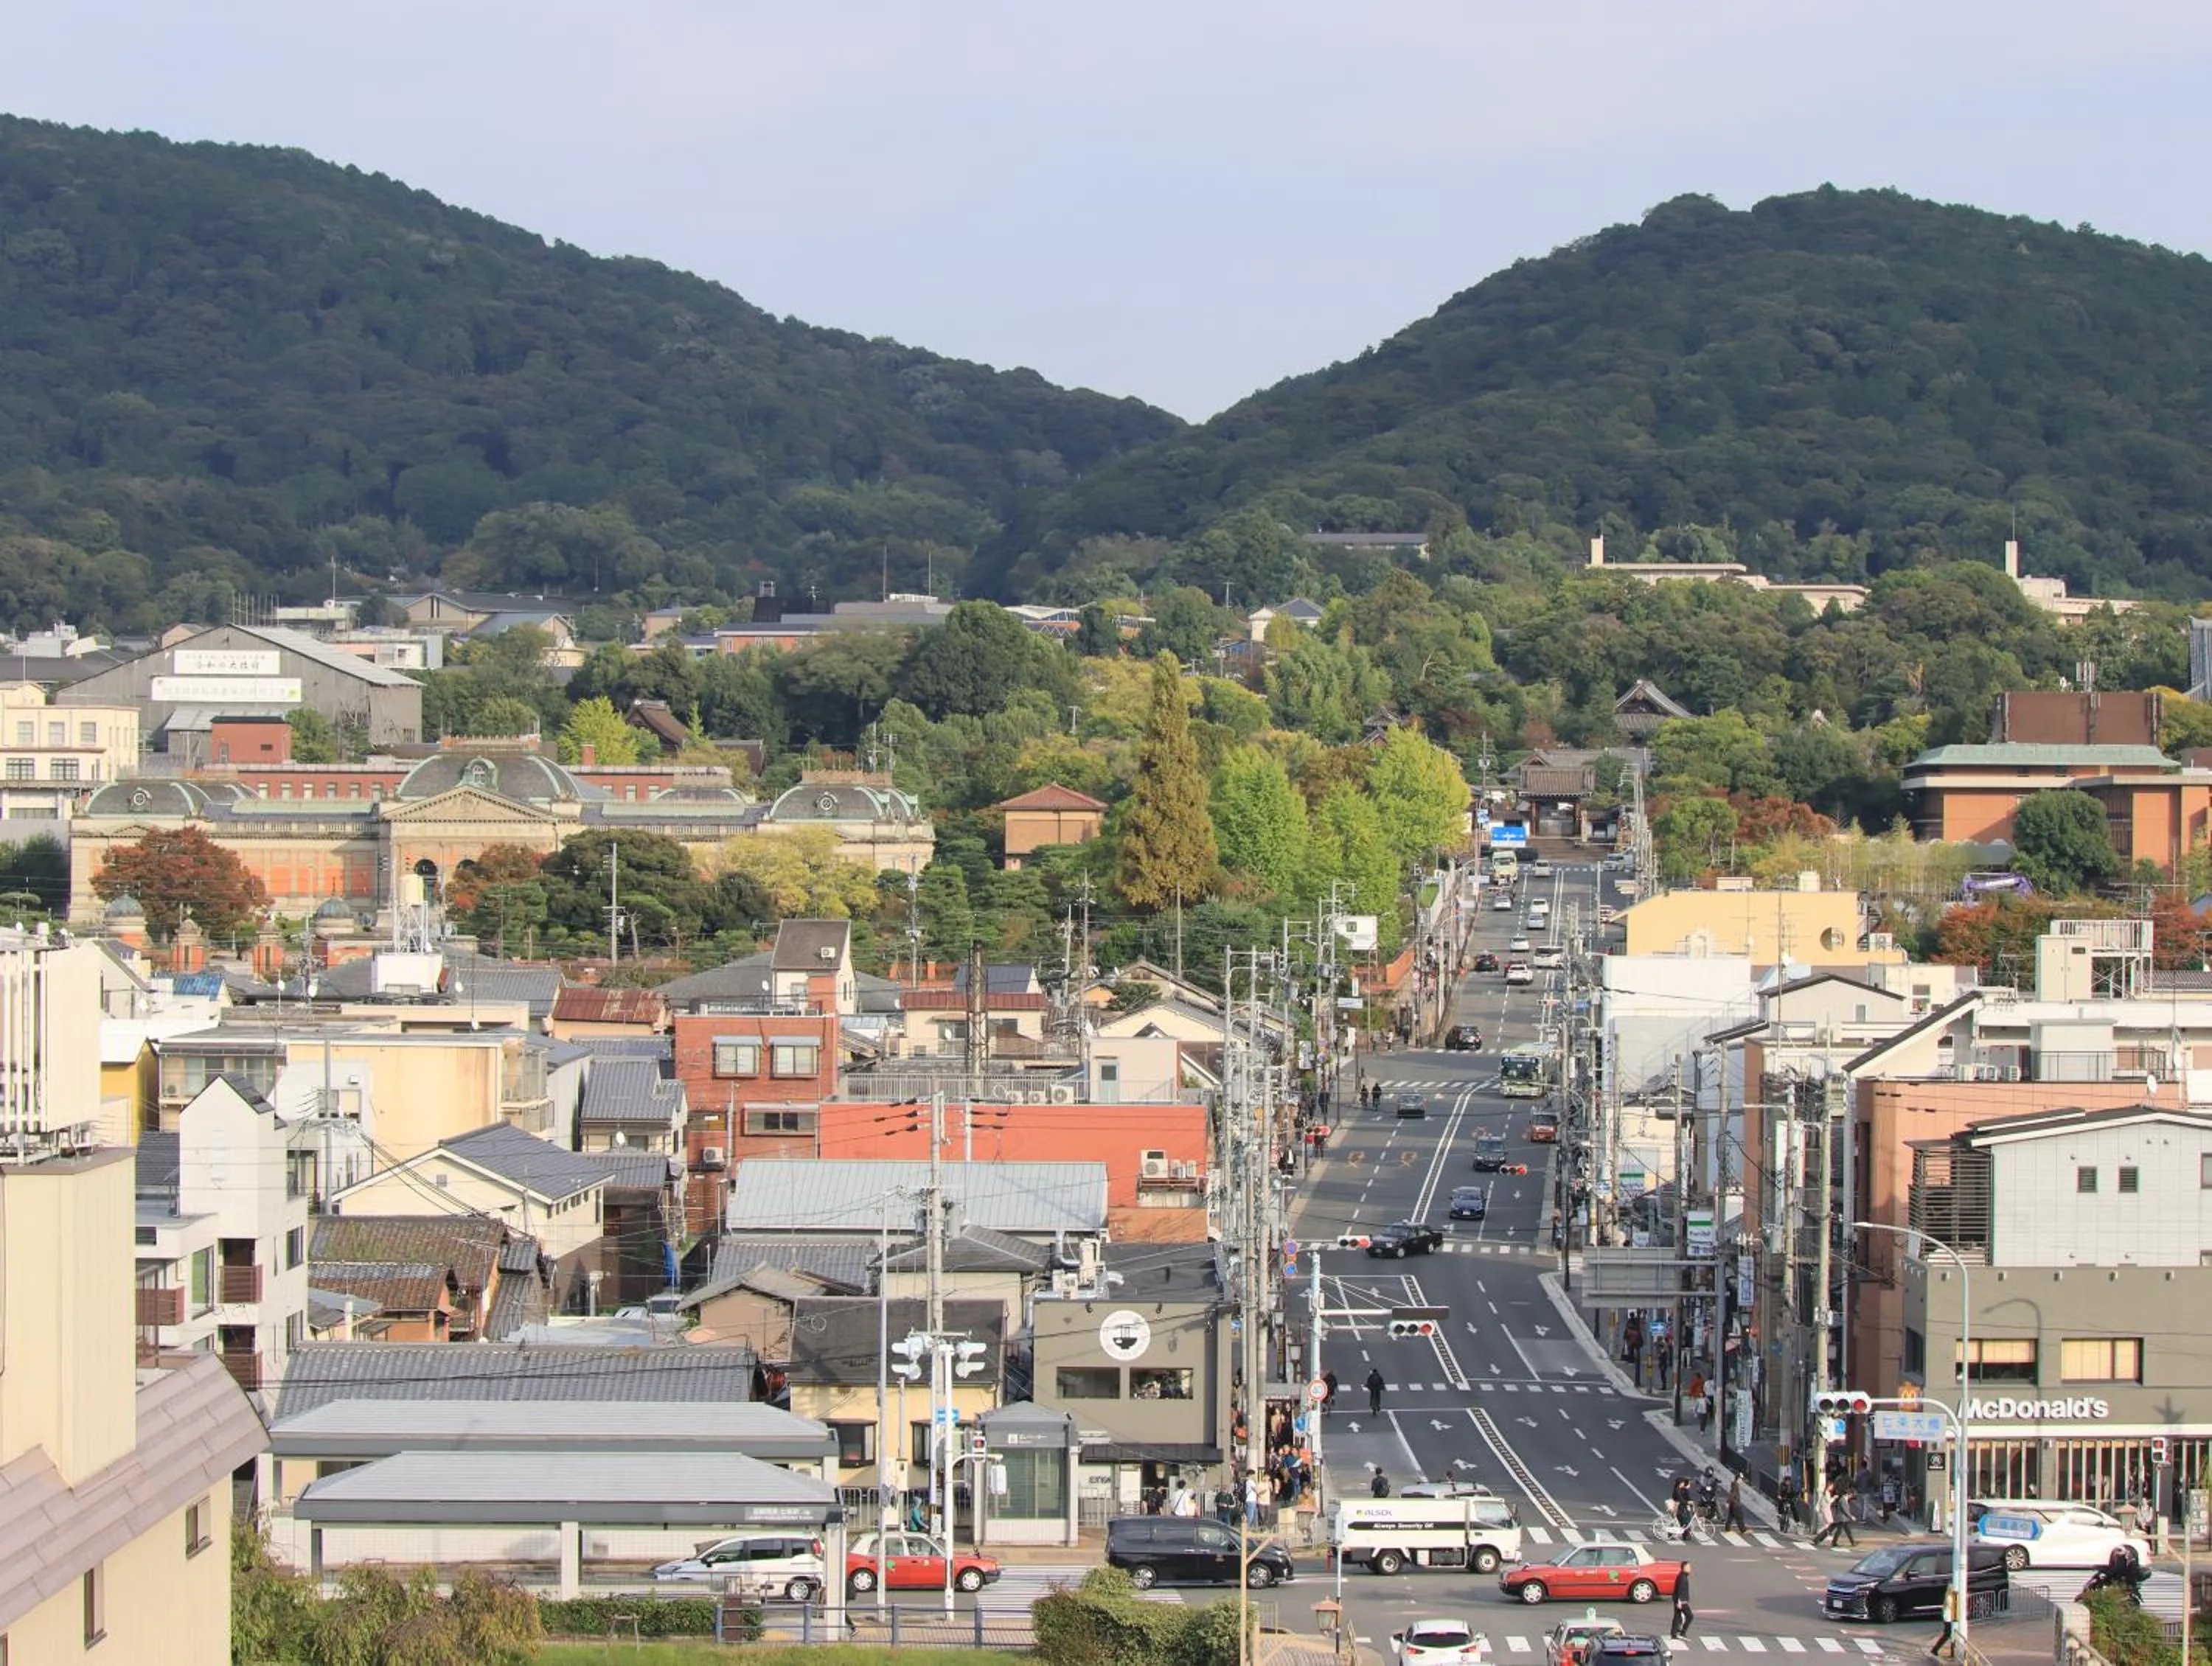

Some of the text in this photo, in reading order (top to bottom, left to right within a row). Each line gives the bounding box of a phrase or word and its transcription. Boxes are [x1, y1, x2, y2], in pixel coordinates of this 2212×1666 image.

[1958, 1397, 2110, 1418] McDonald's
[1373, 1522, 1397, 1530] Always
[1397, 1522, 1423, 1530] Security
